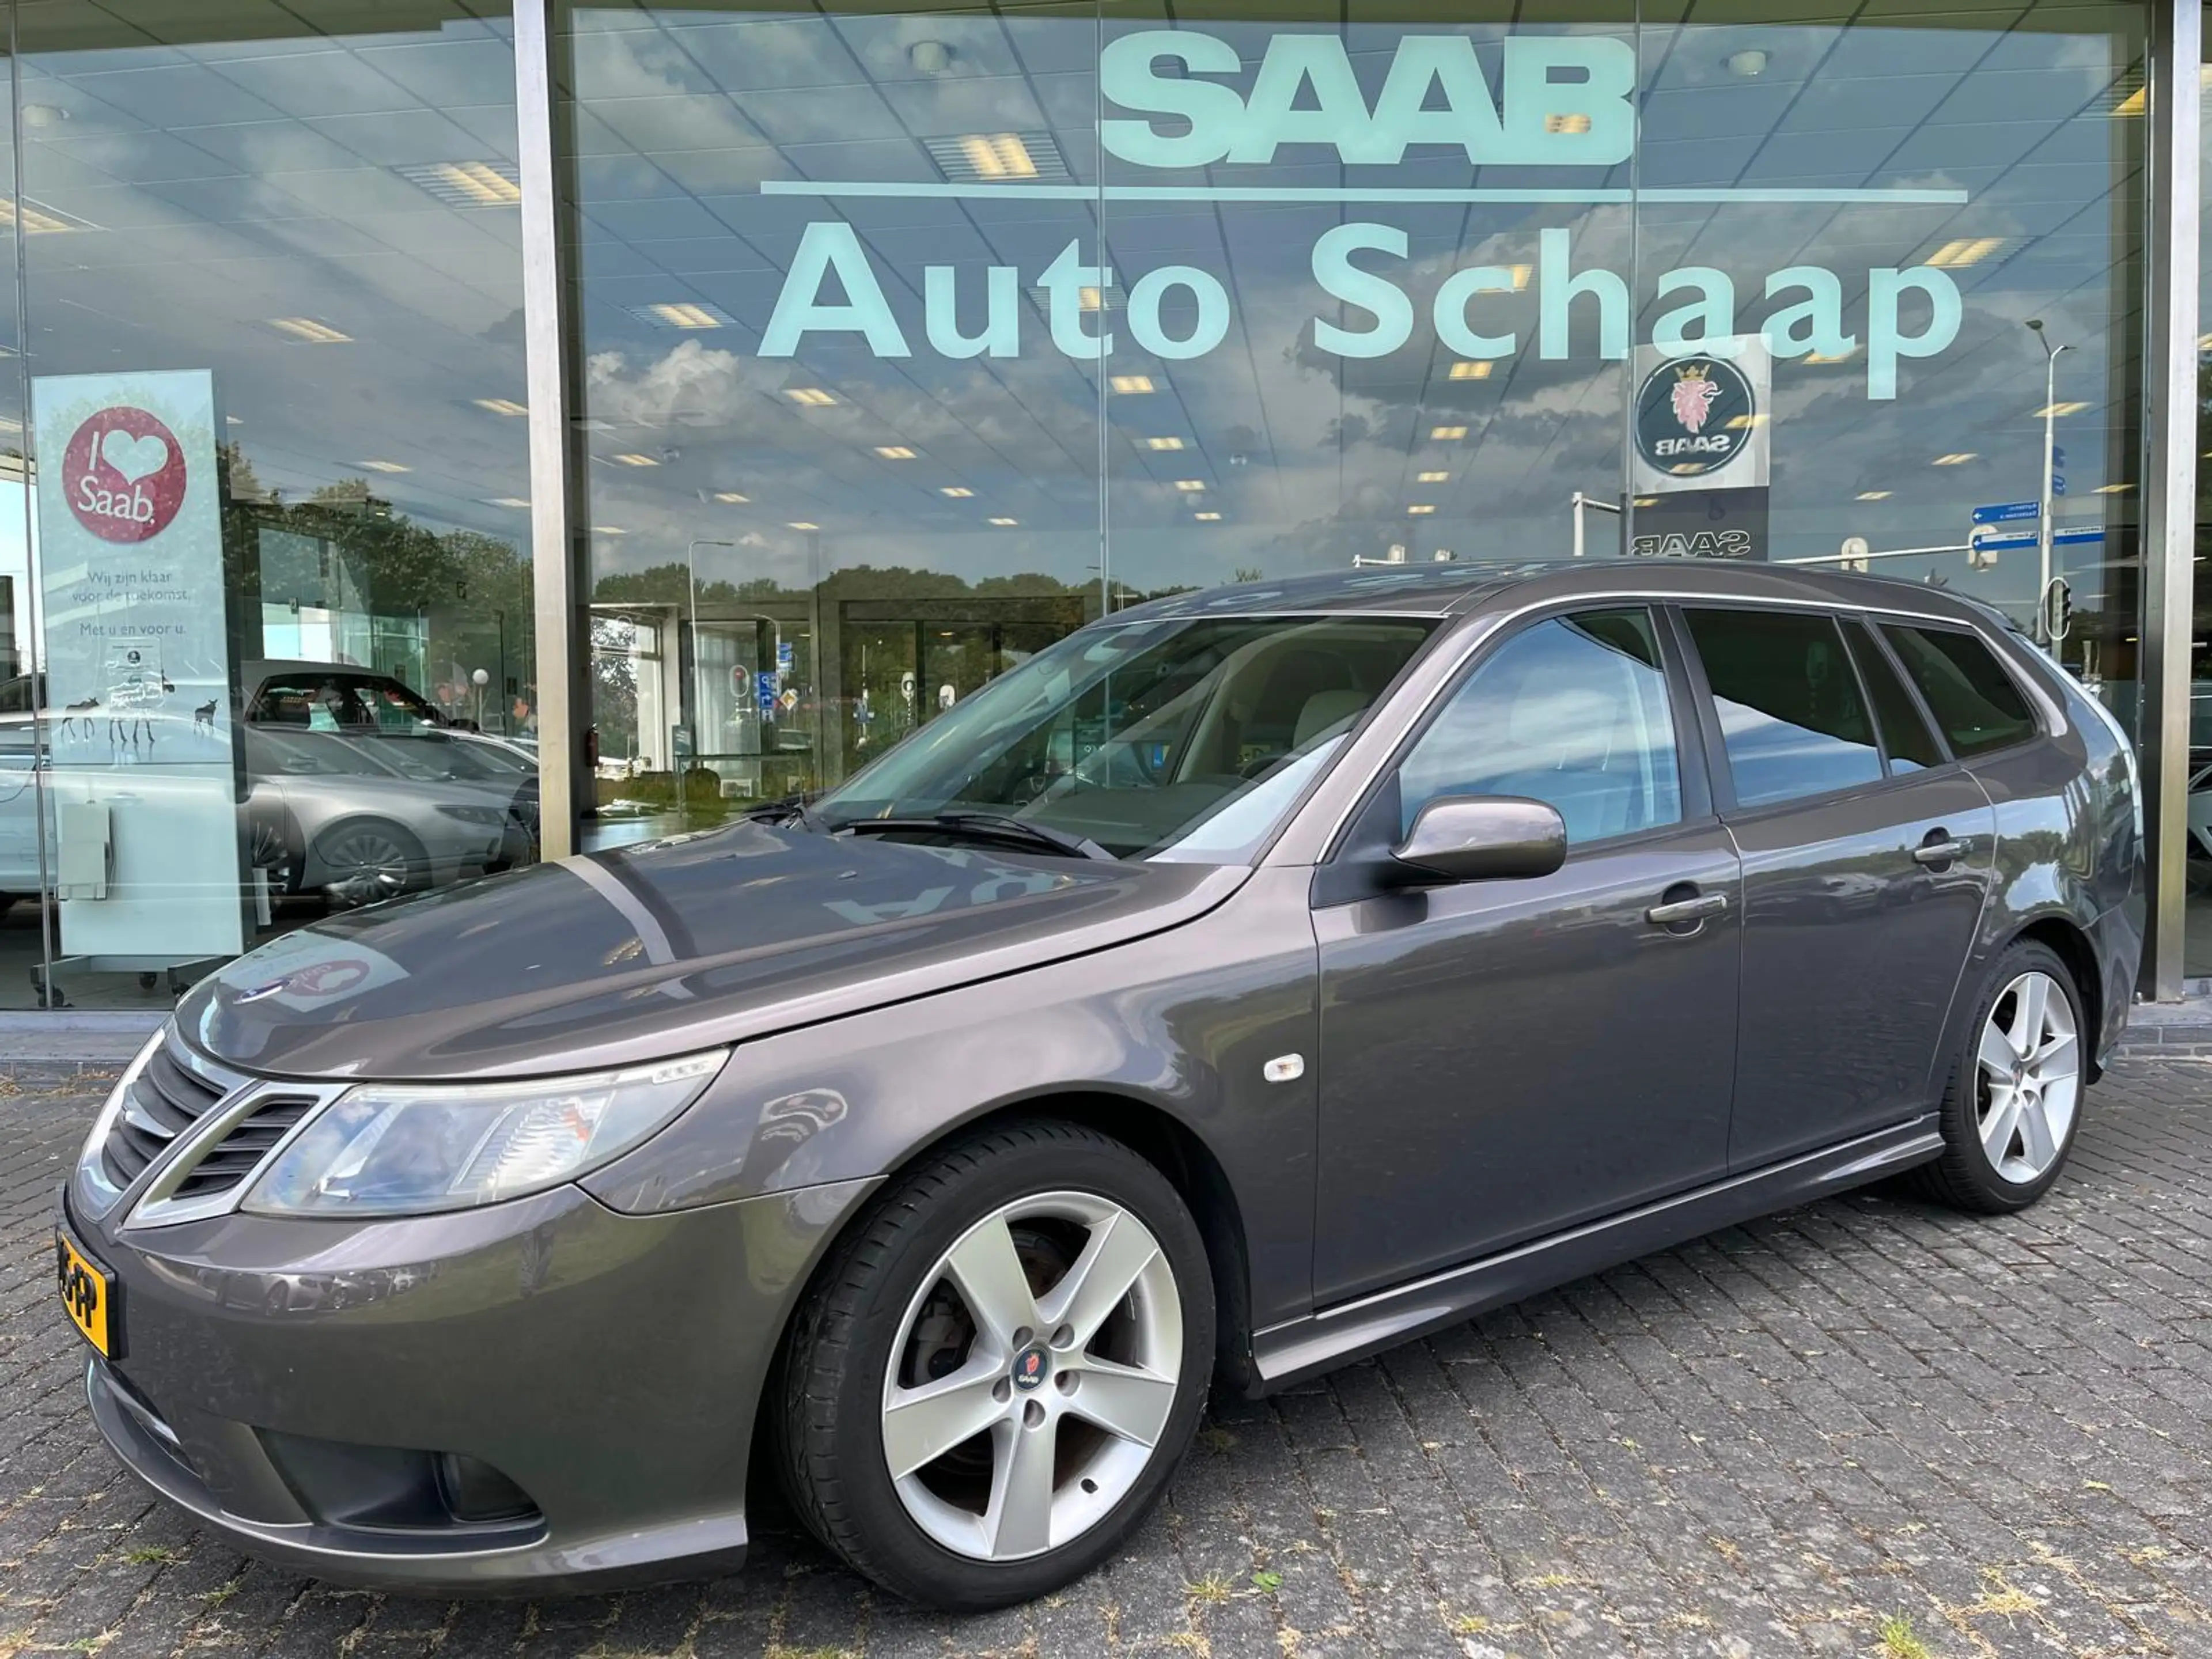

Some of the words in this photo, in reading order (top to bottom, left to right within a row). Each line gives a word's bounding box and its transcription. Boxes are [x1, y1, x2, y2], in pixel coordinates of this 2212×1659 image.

[1099, 29, 1639, 169] SAAB
[757, 222, 1230, 361] Auto
[1311, 222, 1963, 401] Schaap
[87, 569, 111, 586] Wij
[115, 569, 137, 586] zijn
[141, 569, 172, 584] klaar
[72, 593, 103, 602] voor
[79, 623, 105, 636] Met
[109, 627, 116, 635] u
[120, 625, 135, 635] en
[140, 625, 172, 635] voor
